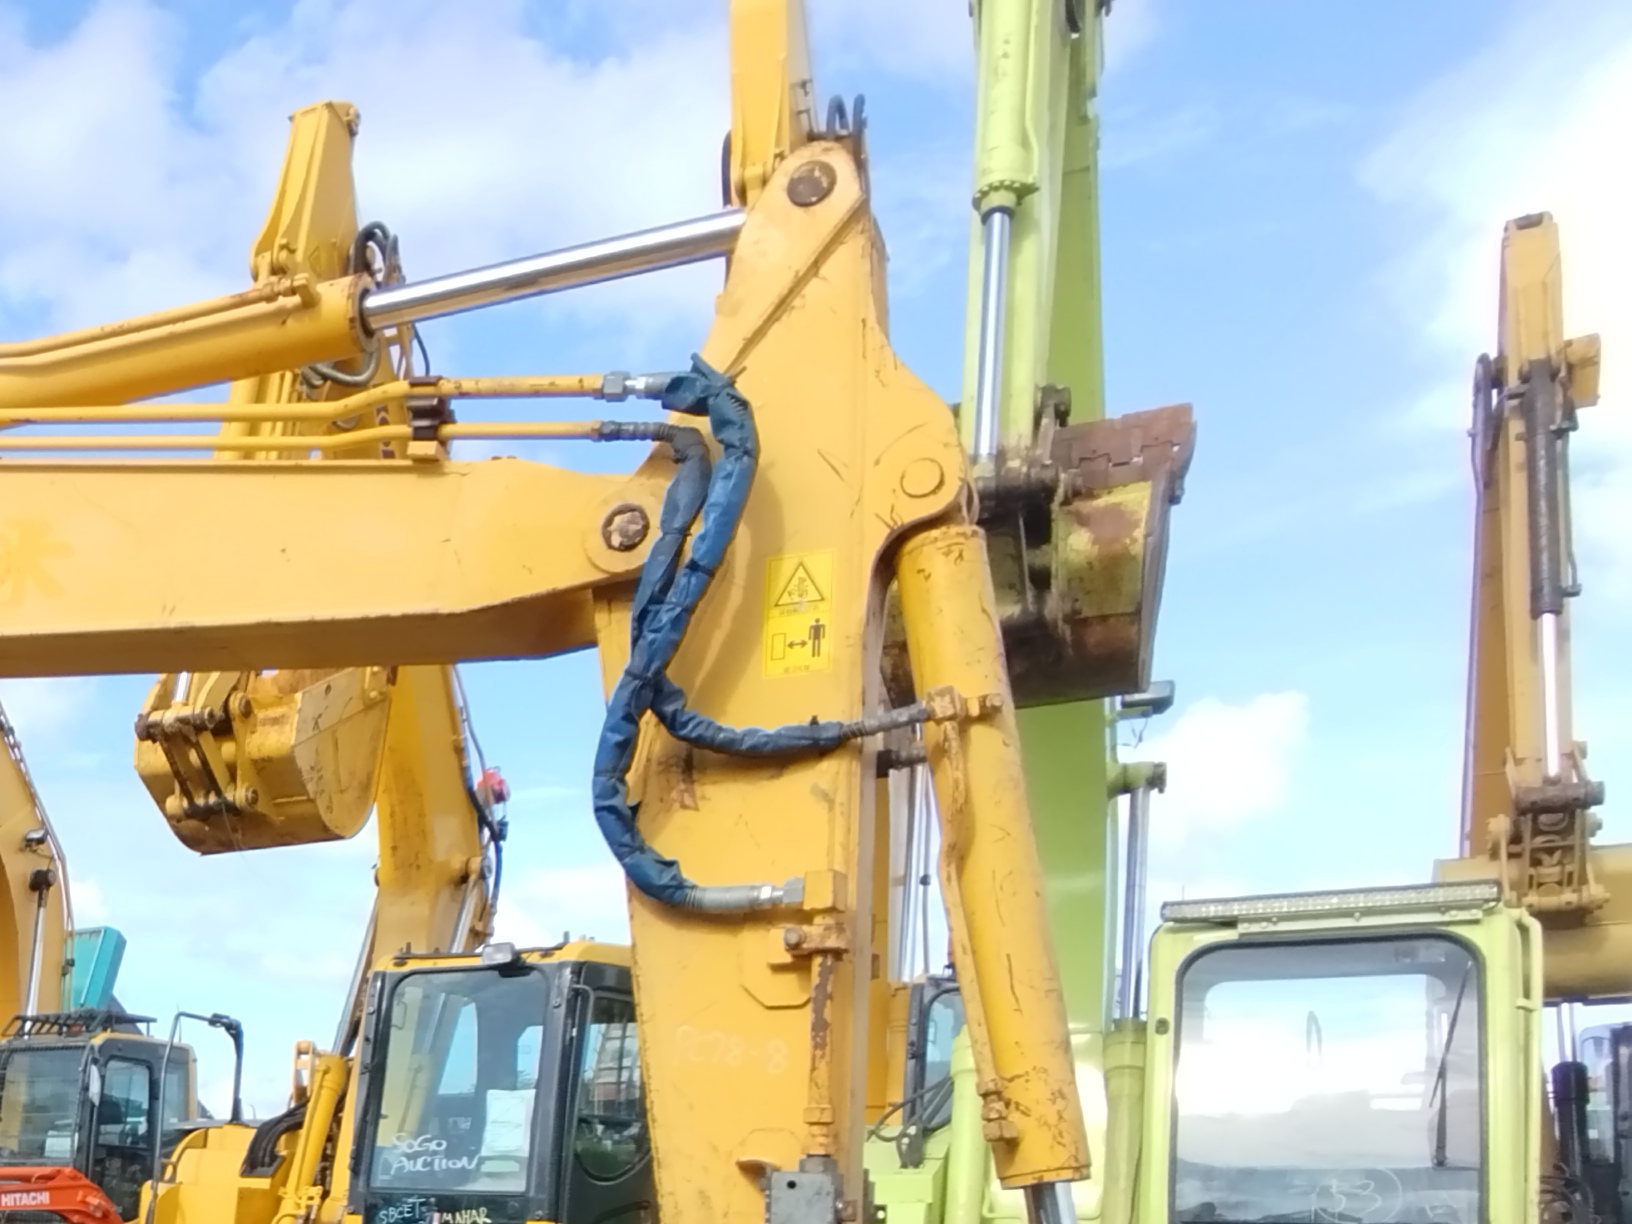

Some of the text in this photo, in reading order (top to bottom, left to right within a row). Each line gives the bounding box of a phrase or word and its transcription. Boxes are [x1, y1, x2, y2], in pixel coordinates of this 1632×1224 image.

[390, 1132, 447, 1154] SOGO
[390, 1154, 481, 1176] AUCTION
[0, 1190, 50, 1207] HITACHI
